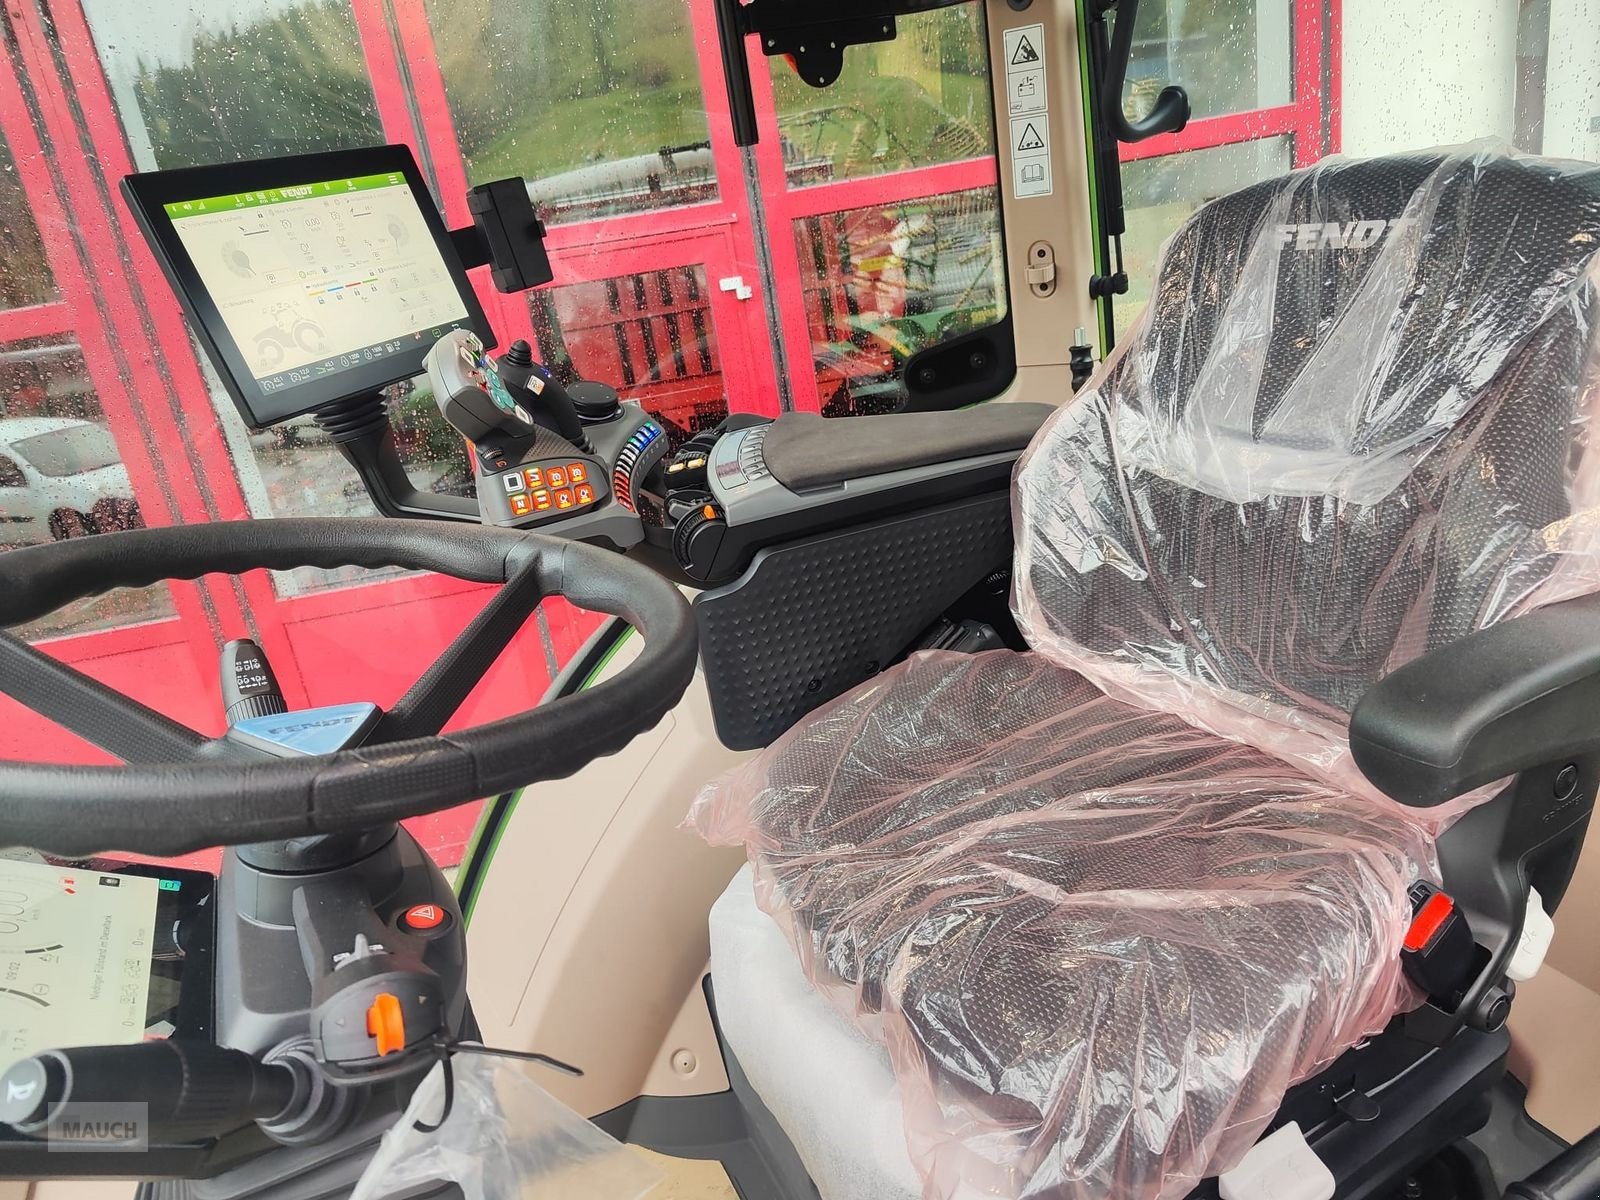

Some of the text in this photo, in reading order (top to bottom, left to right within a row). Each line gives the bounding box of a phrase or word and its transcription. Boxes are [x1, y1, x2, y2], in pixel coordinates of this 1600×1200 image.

[280, 186, 313, 199] FENDT
[1275, 218, 1418, 251] FENDT
[268, 716, 358, 735] FENDT
